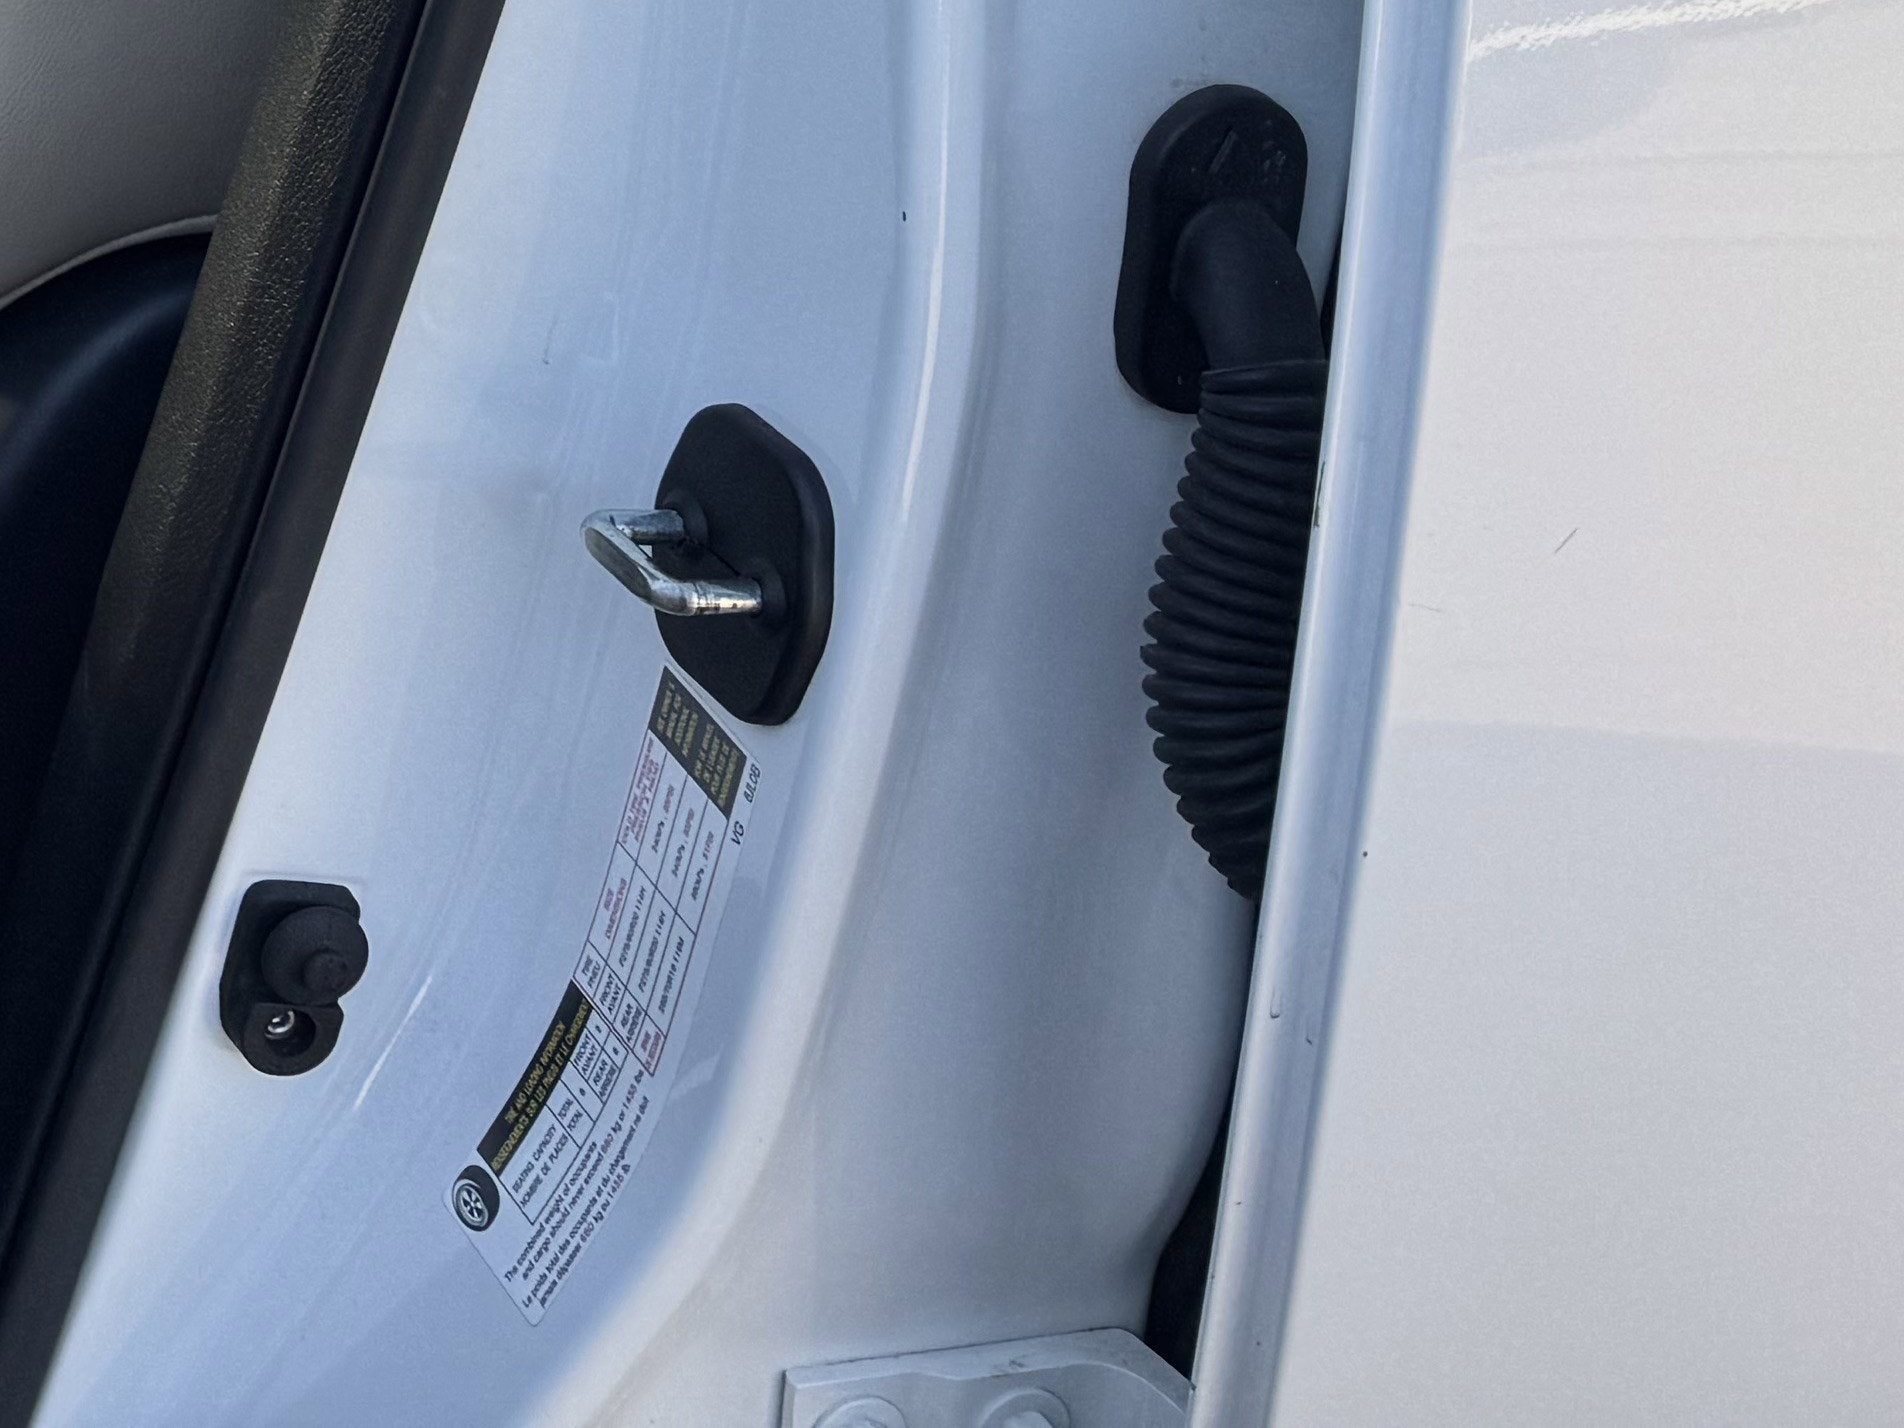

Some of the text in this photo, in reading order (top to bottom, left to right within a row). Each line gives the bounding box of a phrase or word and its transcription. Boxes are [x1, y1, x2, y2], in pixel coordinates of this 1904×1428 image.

[730, 821, 745, 845] VG
[599, 972, 615, 1006] FRONT
[608, 984, 623, 1015] AVANT
[574, 1033, 592, 1067] FRONT
[582, 1046, 600, 1076] AVANT
[594, 1059, 608, 1087] REAR
[558, 1099, 574, 1120] TOTAL
[567, 1110, 583, 1132] TOTAL
[505, 1263, 518, 1283] The
[517, 1223, 545, 1267] combined
[545, 1199, 565, 1227] weight
[570, 1141, 598, 1188] occupants
[523, 1262, 535, 1281] and
[533, 1238, 552, 1266] cargo
[550, 1205, 570, 1238] should
[569, 1183, 583, 1210] never
[582, 1150, 604, 1189] exceed
[523, 1292, 533, 1308] Le
[532, 1271, 548, 1298] poids
[570, 1194, 599, 1239] occupants
[608, 1124, 636, 1177] chargement
